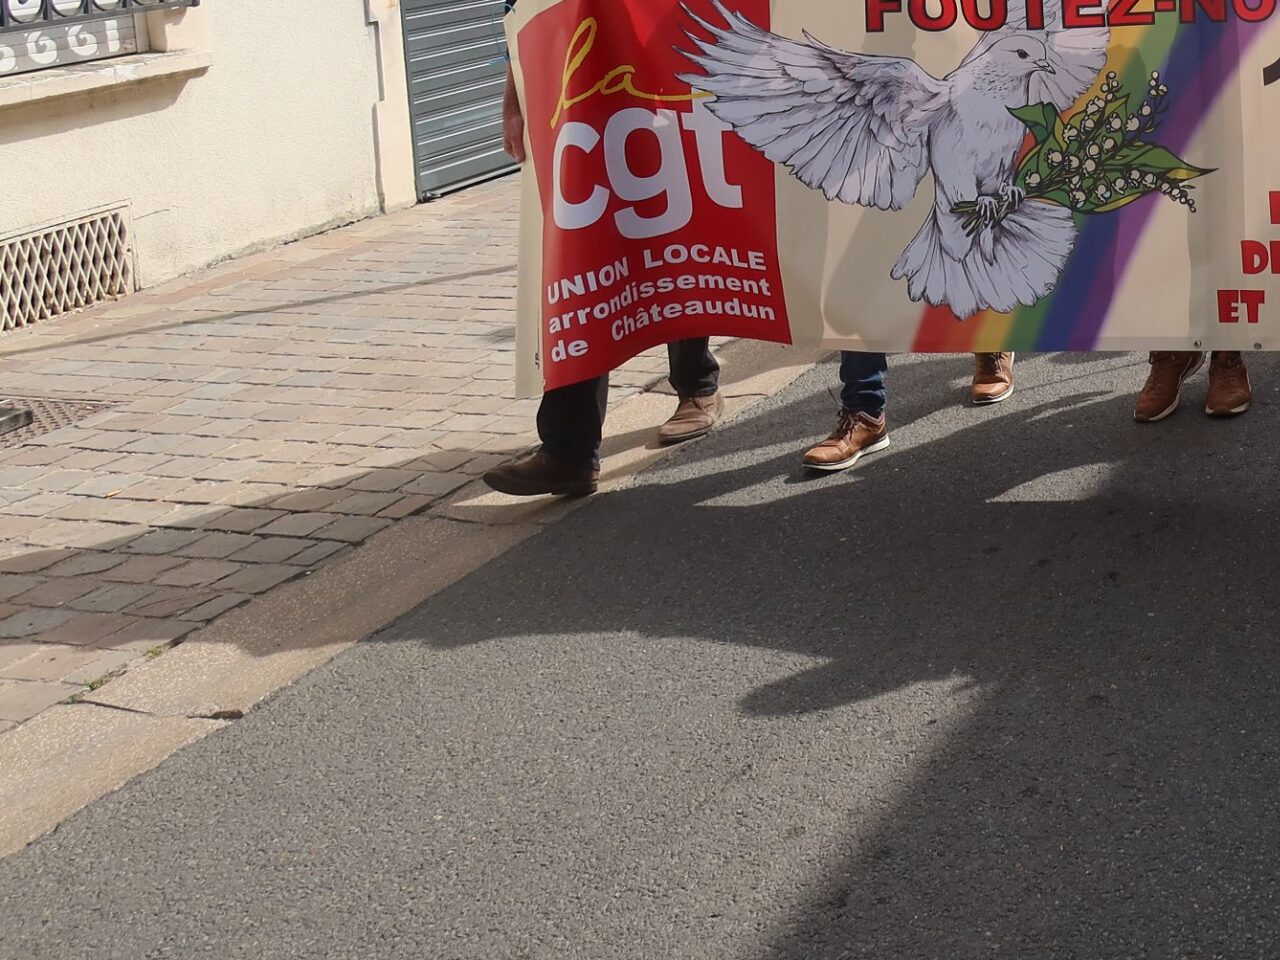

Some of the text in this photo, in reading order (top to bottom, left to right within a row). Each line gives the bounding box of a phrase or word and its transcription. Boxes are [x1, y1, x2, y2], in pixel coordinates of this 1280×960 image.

[553, 84, 744, 239] cgt
[547, 244, 767, 305] UNION LOCALE
[549, 274, 772, 334] arrondissement
[551, 297, 776, 363] de Châteaudun
[1216, 289, 1265, 324] ET
